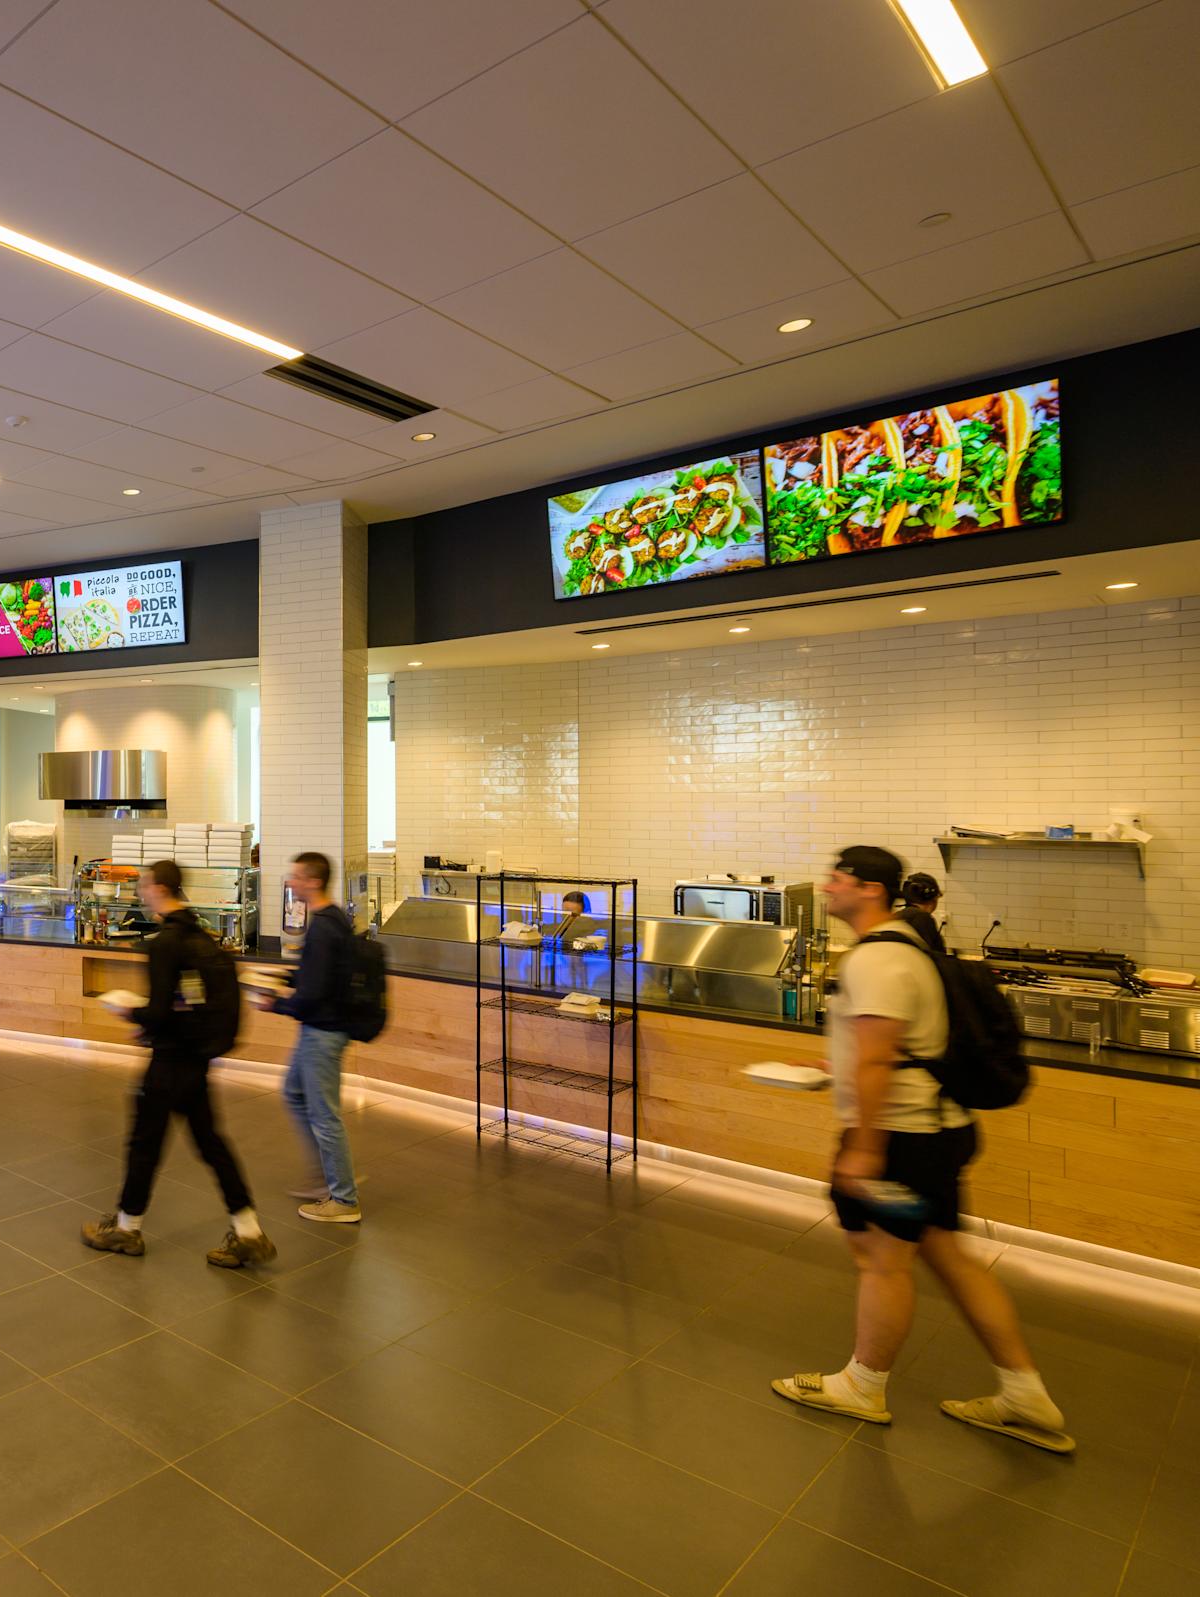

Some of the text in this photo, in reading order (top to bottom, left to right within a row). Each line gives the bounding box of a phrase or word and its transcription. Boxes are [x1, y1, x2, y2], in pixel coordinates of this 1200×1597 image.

[126, 568, 176, 581] DO GOOD,
[91, 587, 116, 597] italia
[128, 581, 177, 596] BE NICE,
[129, 612, 179, 629] PIZZA,
[129, 629, 180, 643] REPEAT
